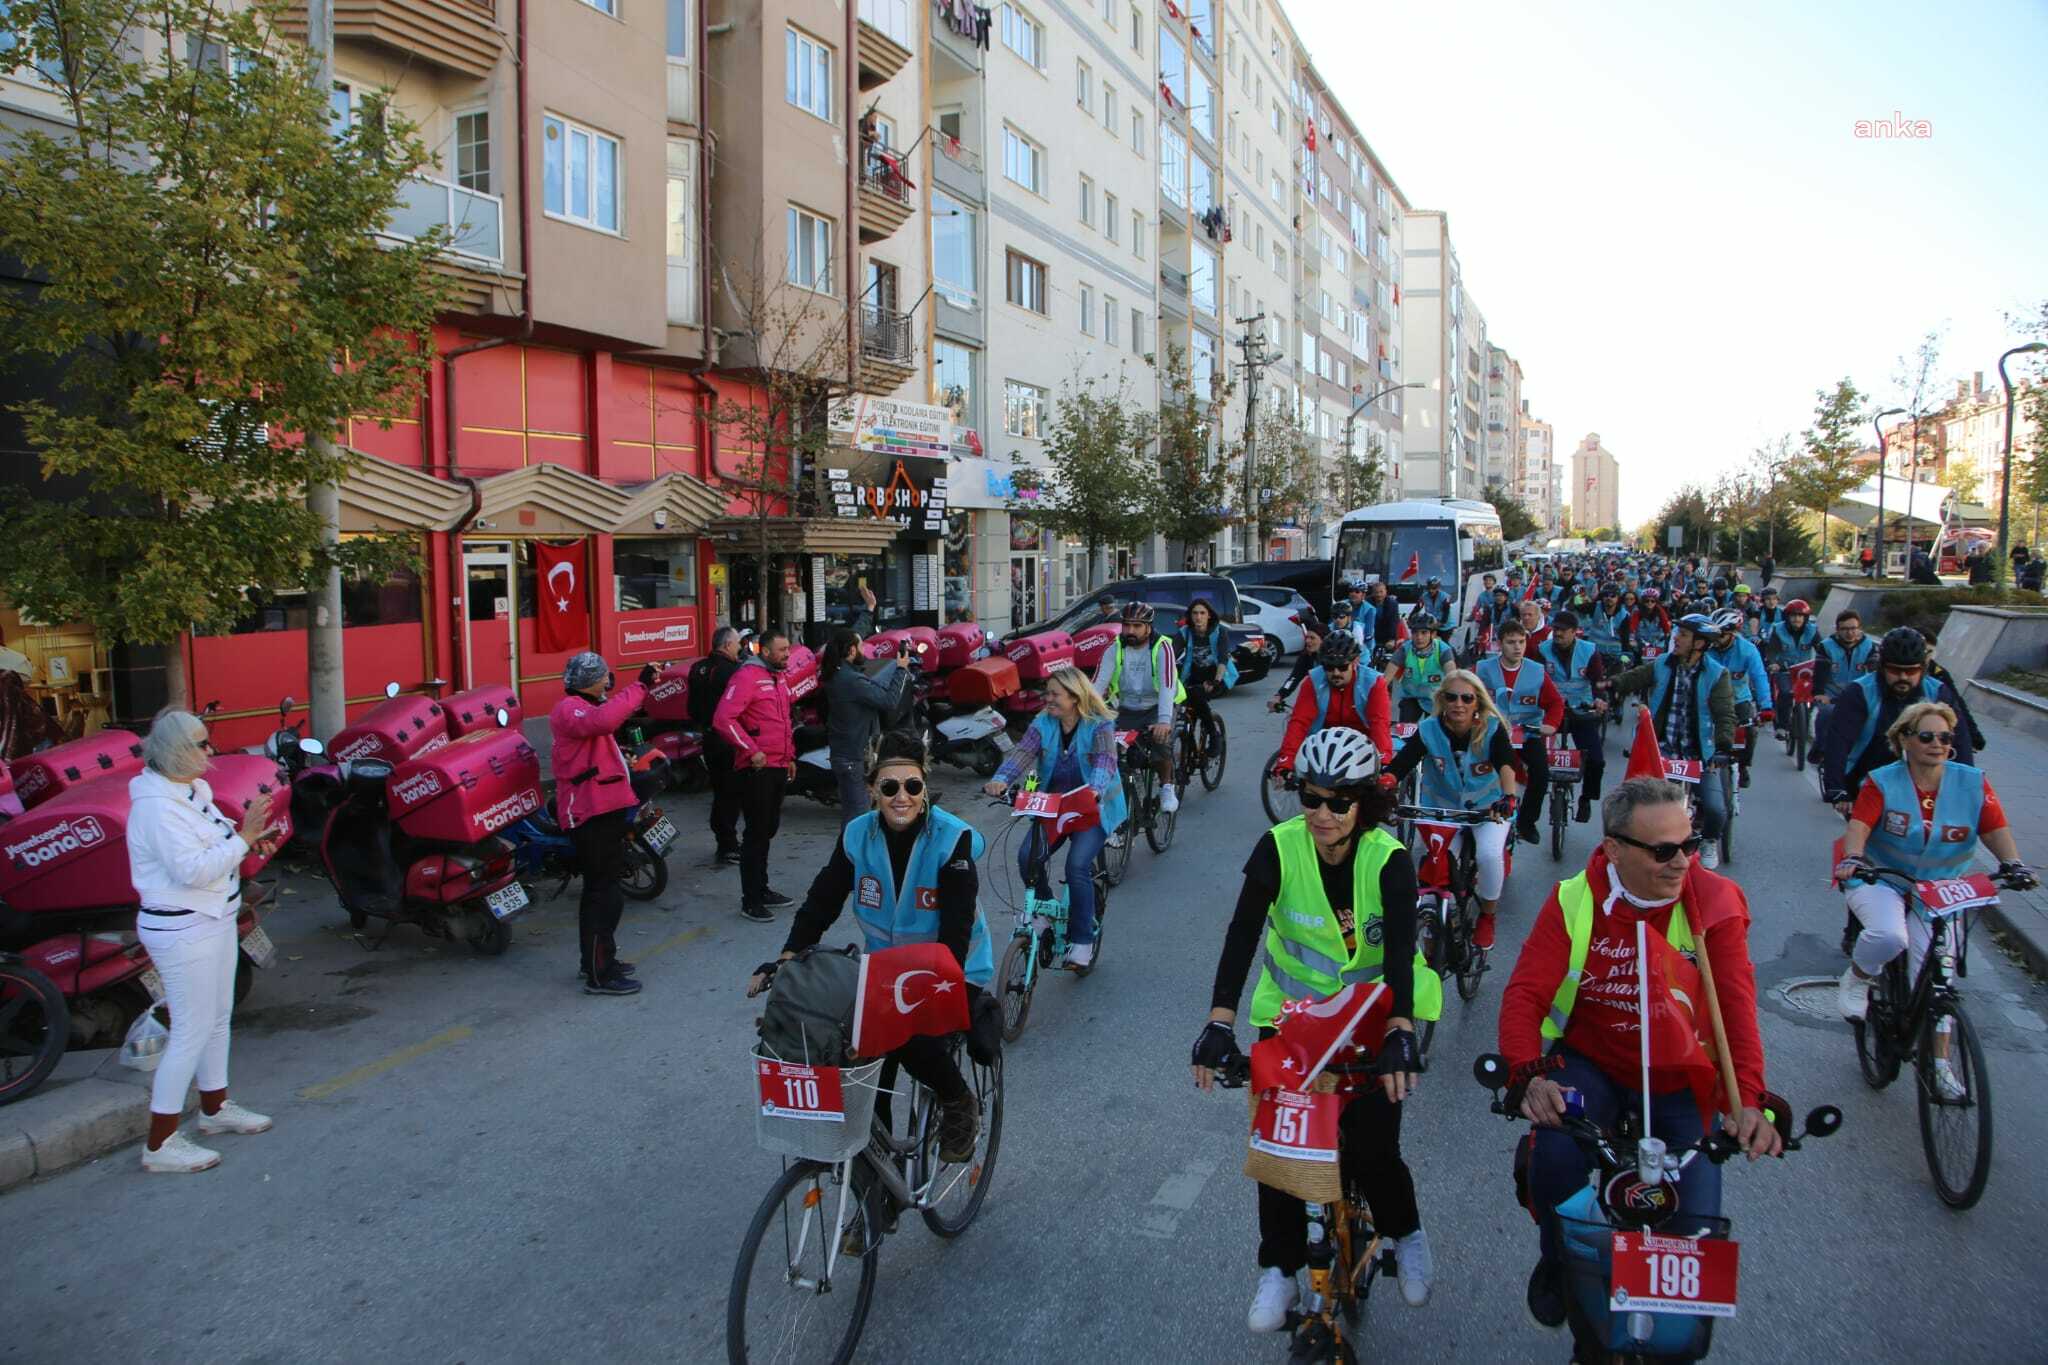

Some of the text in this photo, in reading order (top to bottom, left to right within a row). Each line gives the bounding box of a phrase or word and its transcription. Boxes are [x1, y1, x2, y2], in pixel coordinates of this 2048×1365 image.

[857, 486, 929, 508] ROBOSHOP
[1669, 760, 1689, 776] 157
[1024, 796, 1049, 811] 231
[1936, 880, 1978, 906] 030
[783, 1077, 819, 1109] 110
[1272, 1105, 1310, 1146] 151
[1645, 1252, 1701, 1299] 198
